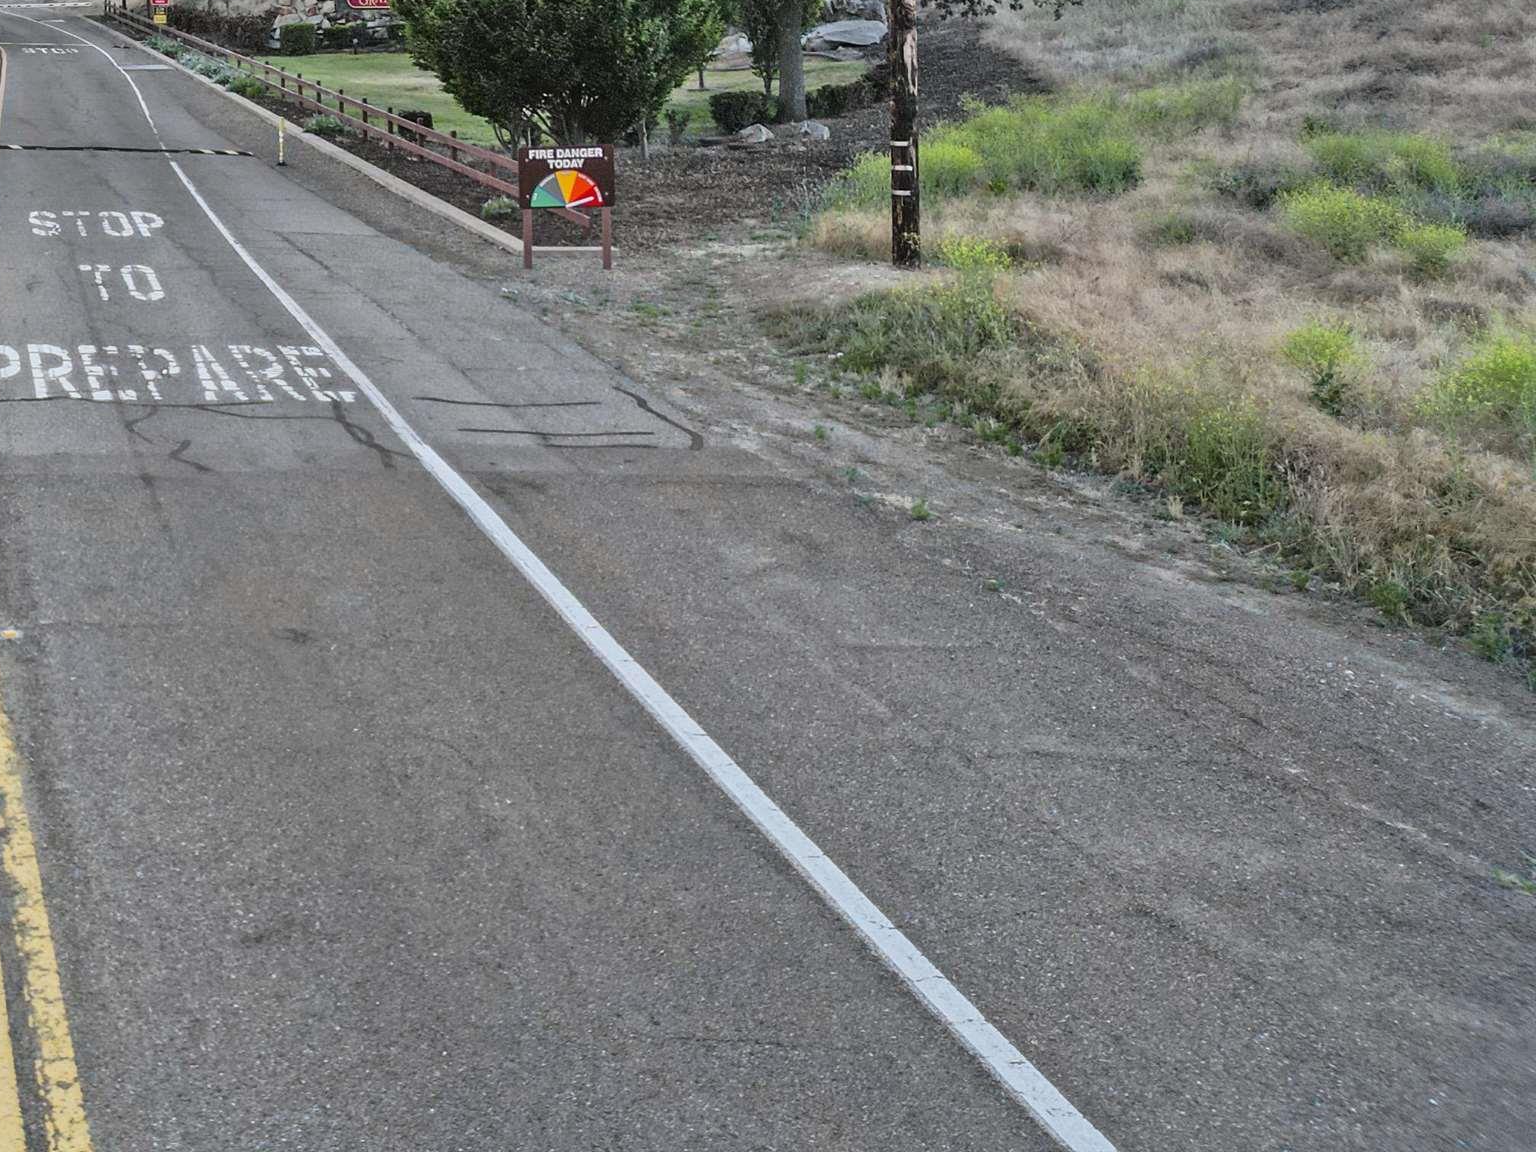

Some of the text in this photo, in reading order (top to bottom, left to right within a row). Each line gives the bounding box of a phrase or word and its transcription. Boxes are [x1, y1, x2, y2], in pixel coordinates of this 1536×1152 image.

[528, 147, 603, 160] FIRE DANGER
[547, 159, 584, 169] TODAY
[28, 211, 164, 237] STOP
[78, 264, 165, 301] TO
